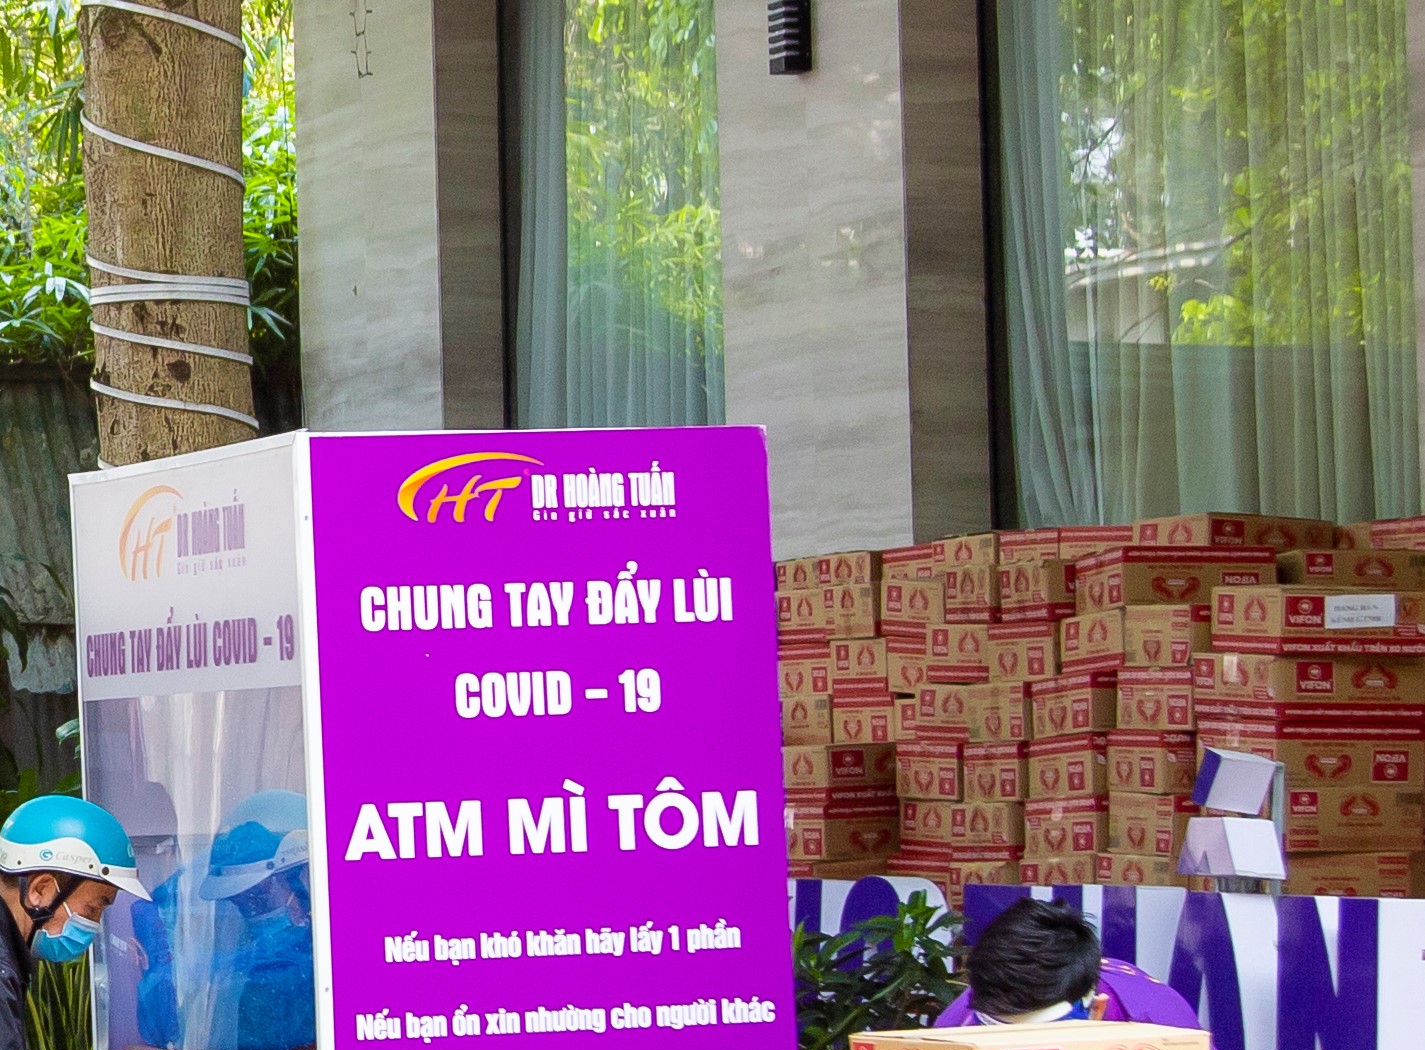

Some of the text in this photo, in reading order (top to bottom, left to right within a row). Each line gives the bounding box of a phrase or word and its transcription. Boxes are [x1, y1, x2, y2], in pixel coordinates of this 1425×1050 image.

[531, 474, 558, 508] DR
[563, 467, 625, 508] HOÀNG
[360, 560, 733, 631] CHUNG TAY ĐẨY LÙI
[1288, 613, 1322, 624] VIFON
[86, 631, 126, 677] CHUNG
[130, 629, 152, 673] TAY
[156, 607, 181, 671] ĐẨY
[186, 614, 207, 669] LÙI
[213, 617, 257, 666] COVID
[277, 614, 295, 660] 19
[455, 670, 572, 718] COVID
[618, 668, 661, 712] 19
[345, 776, 758, 861] ATM MÌ TÔM
[384, 918, 741, 966] Nếu bạn khó khăn hãy lấy 1 phần
[356, 995, 775, 1043] Nếu bạn ổn xin nhường cho người khác
